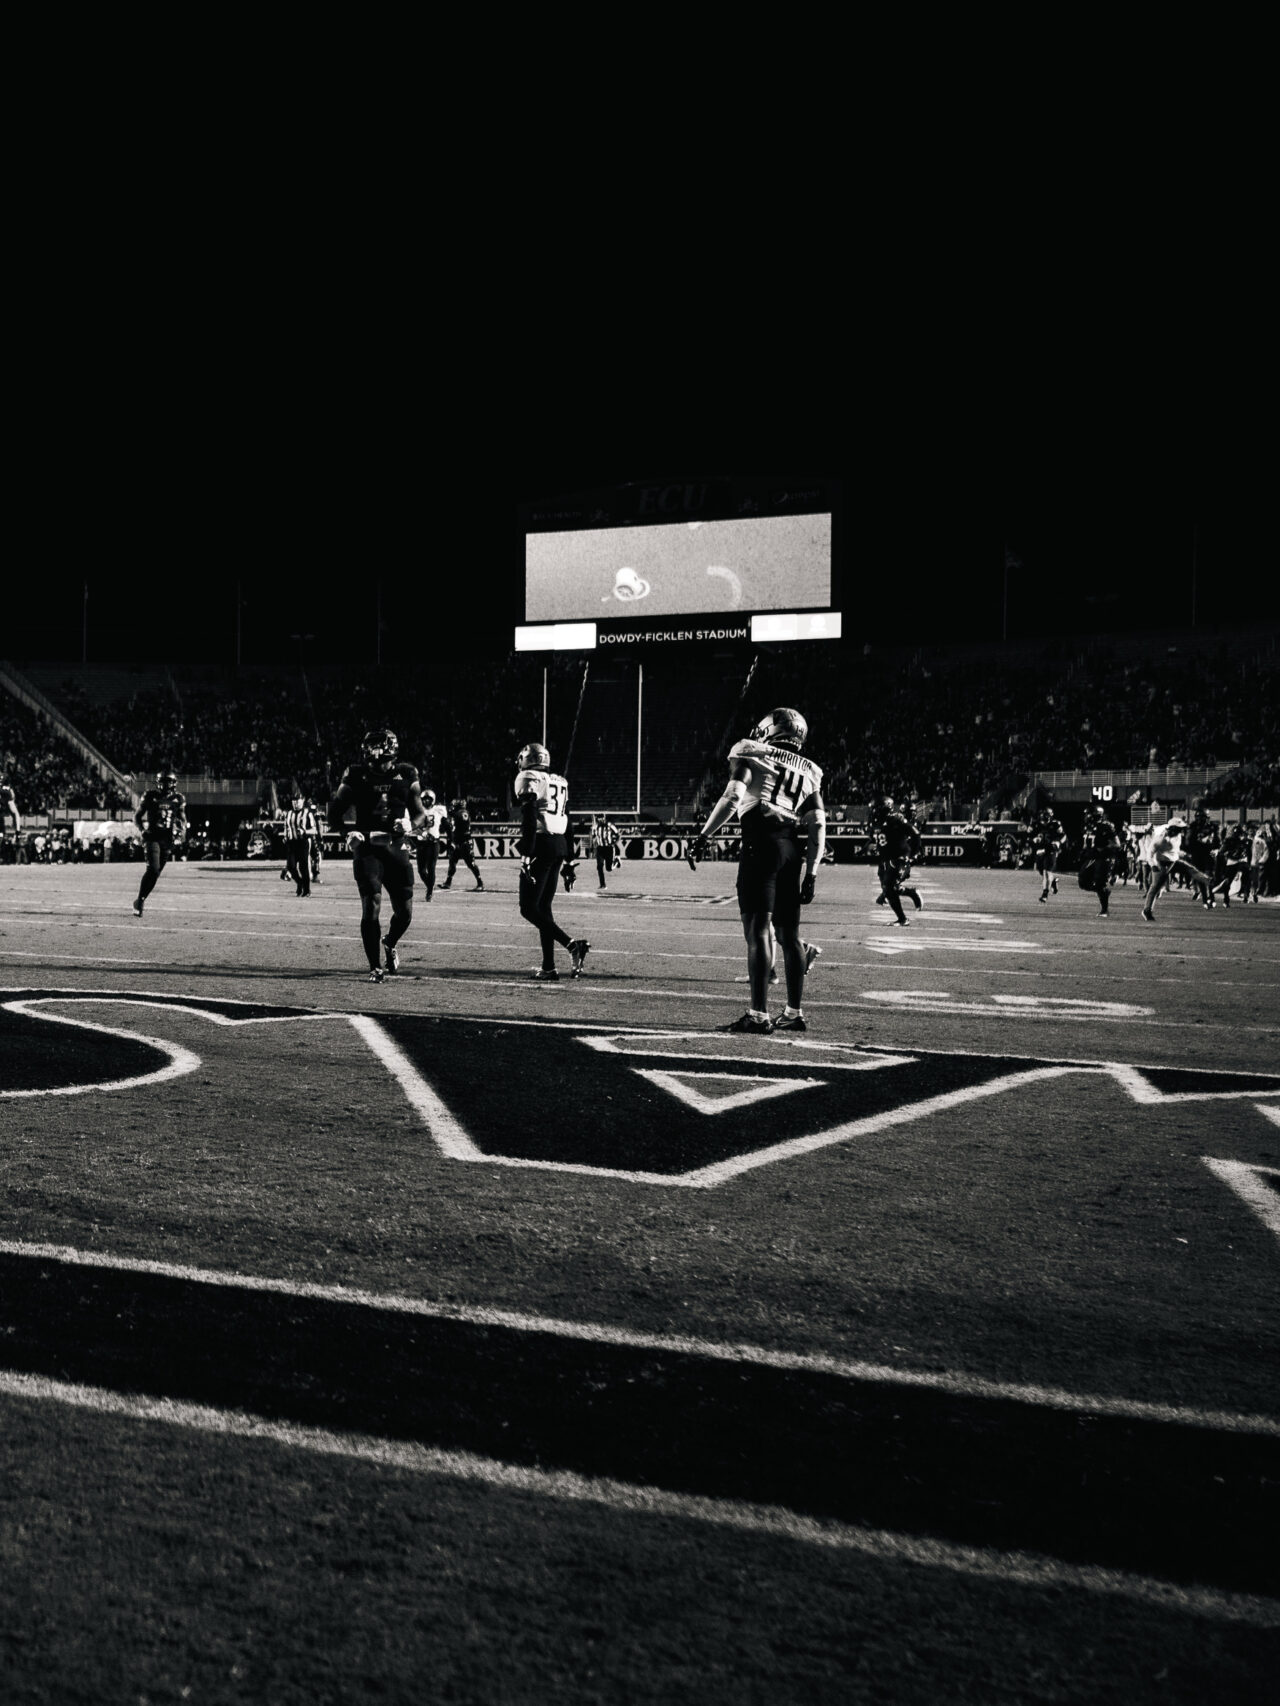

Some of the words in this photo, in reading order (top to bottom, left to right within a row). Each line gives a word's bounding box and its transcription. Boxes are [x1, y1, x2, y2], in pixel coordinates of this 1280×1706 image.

[638, 484, 708, 515] ECU
[599, 630, 691, 645] DOWDY-FICKLEN
[695, 628, 746, 641] STADIUM
[546, 784, 568, 817] 37
[767, 765, 805, 812] 14
[1092, 785, 1113, 802] 40
[923, 845, 963, 857] FIELD
